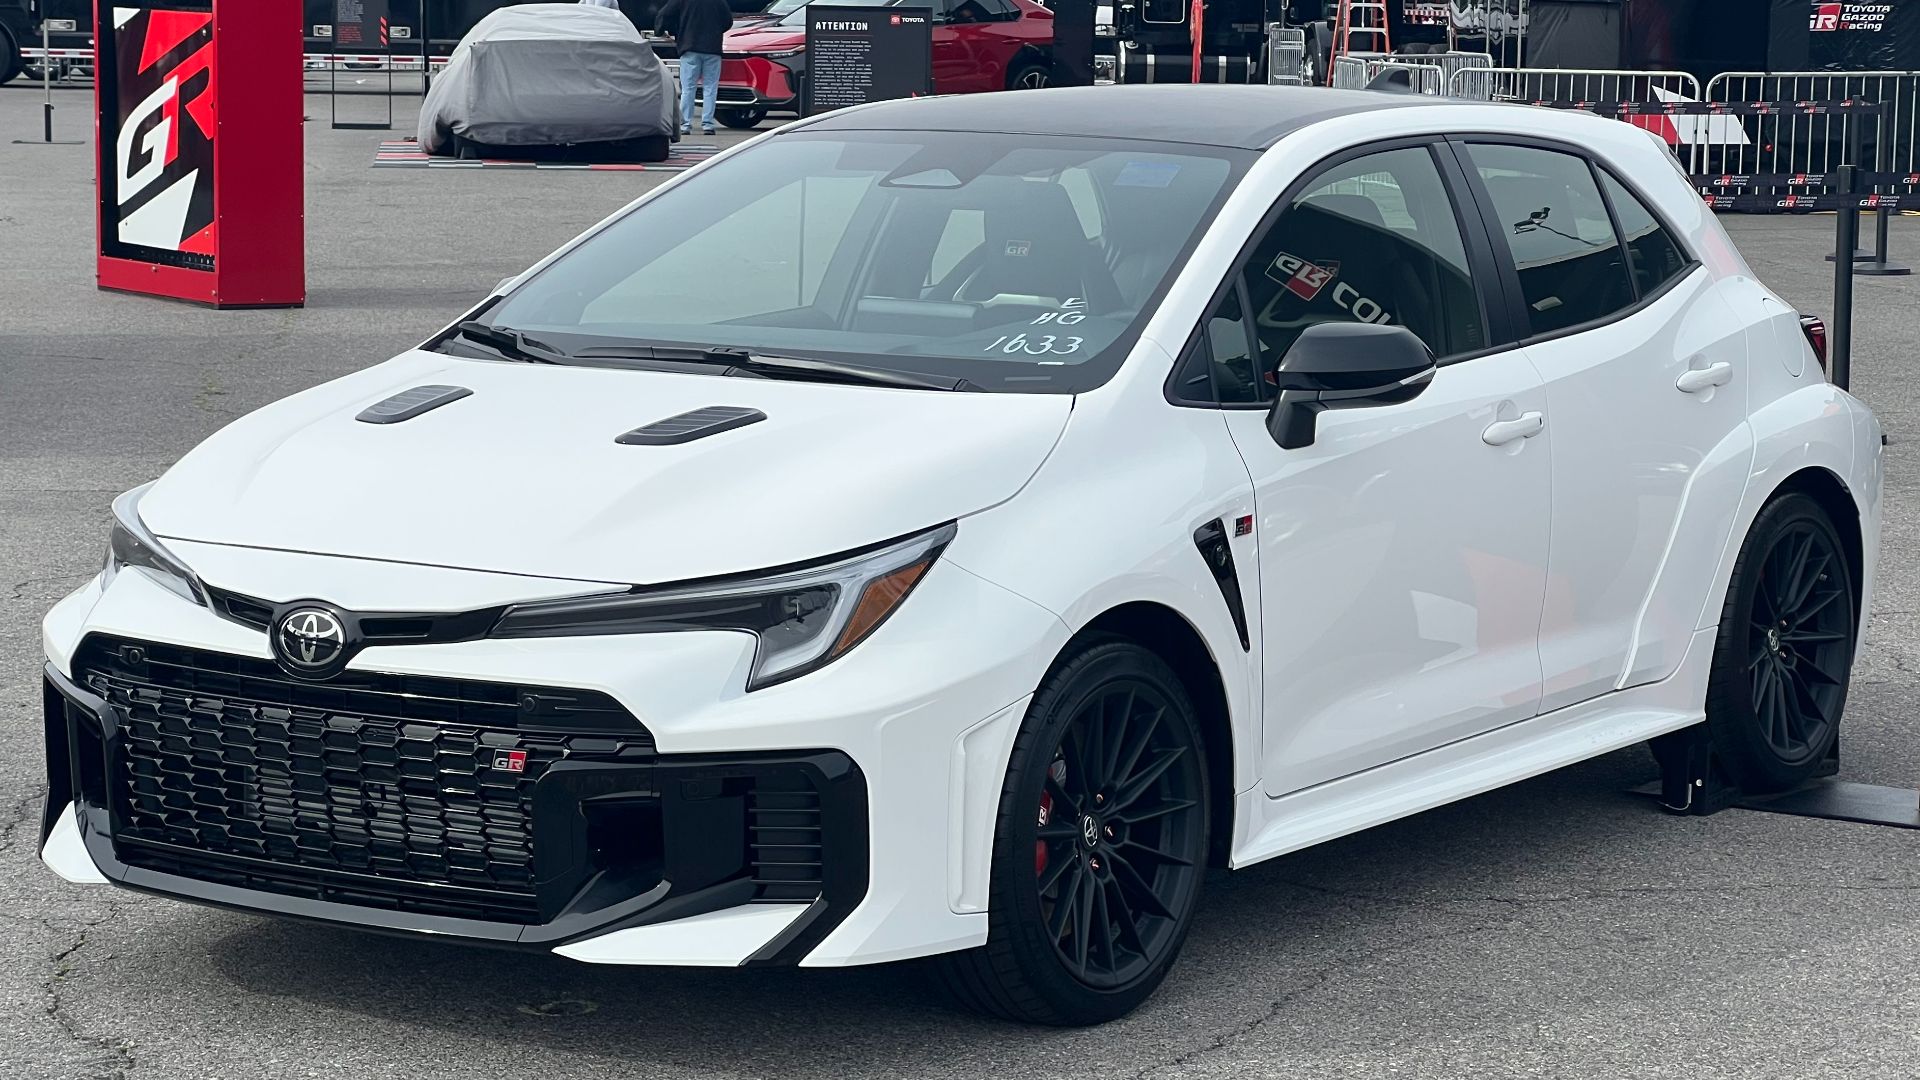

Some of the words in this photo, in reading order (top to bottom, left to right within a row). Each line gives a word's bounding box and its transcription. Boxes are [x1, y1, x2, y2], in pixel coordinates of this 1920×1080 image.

[1844, 4, 1891, 13] TOYOTA
[815, 21, 868, 31] ATTENTION
[1840, 21, 1883, 32] Racing
[117, 41, 214, 206] GR
[1713, 178, 1730, 186] GR
[1776, 199, 1795, 207] GR
[1006, 245, 1029, 256] GR
[984, 333, 1084, 355] 1633
[494, 757, 523, 769] GR
